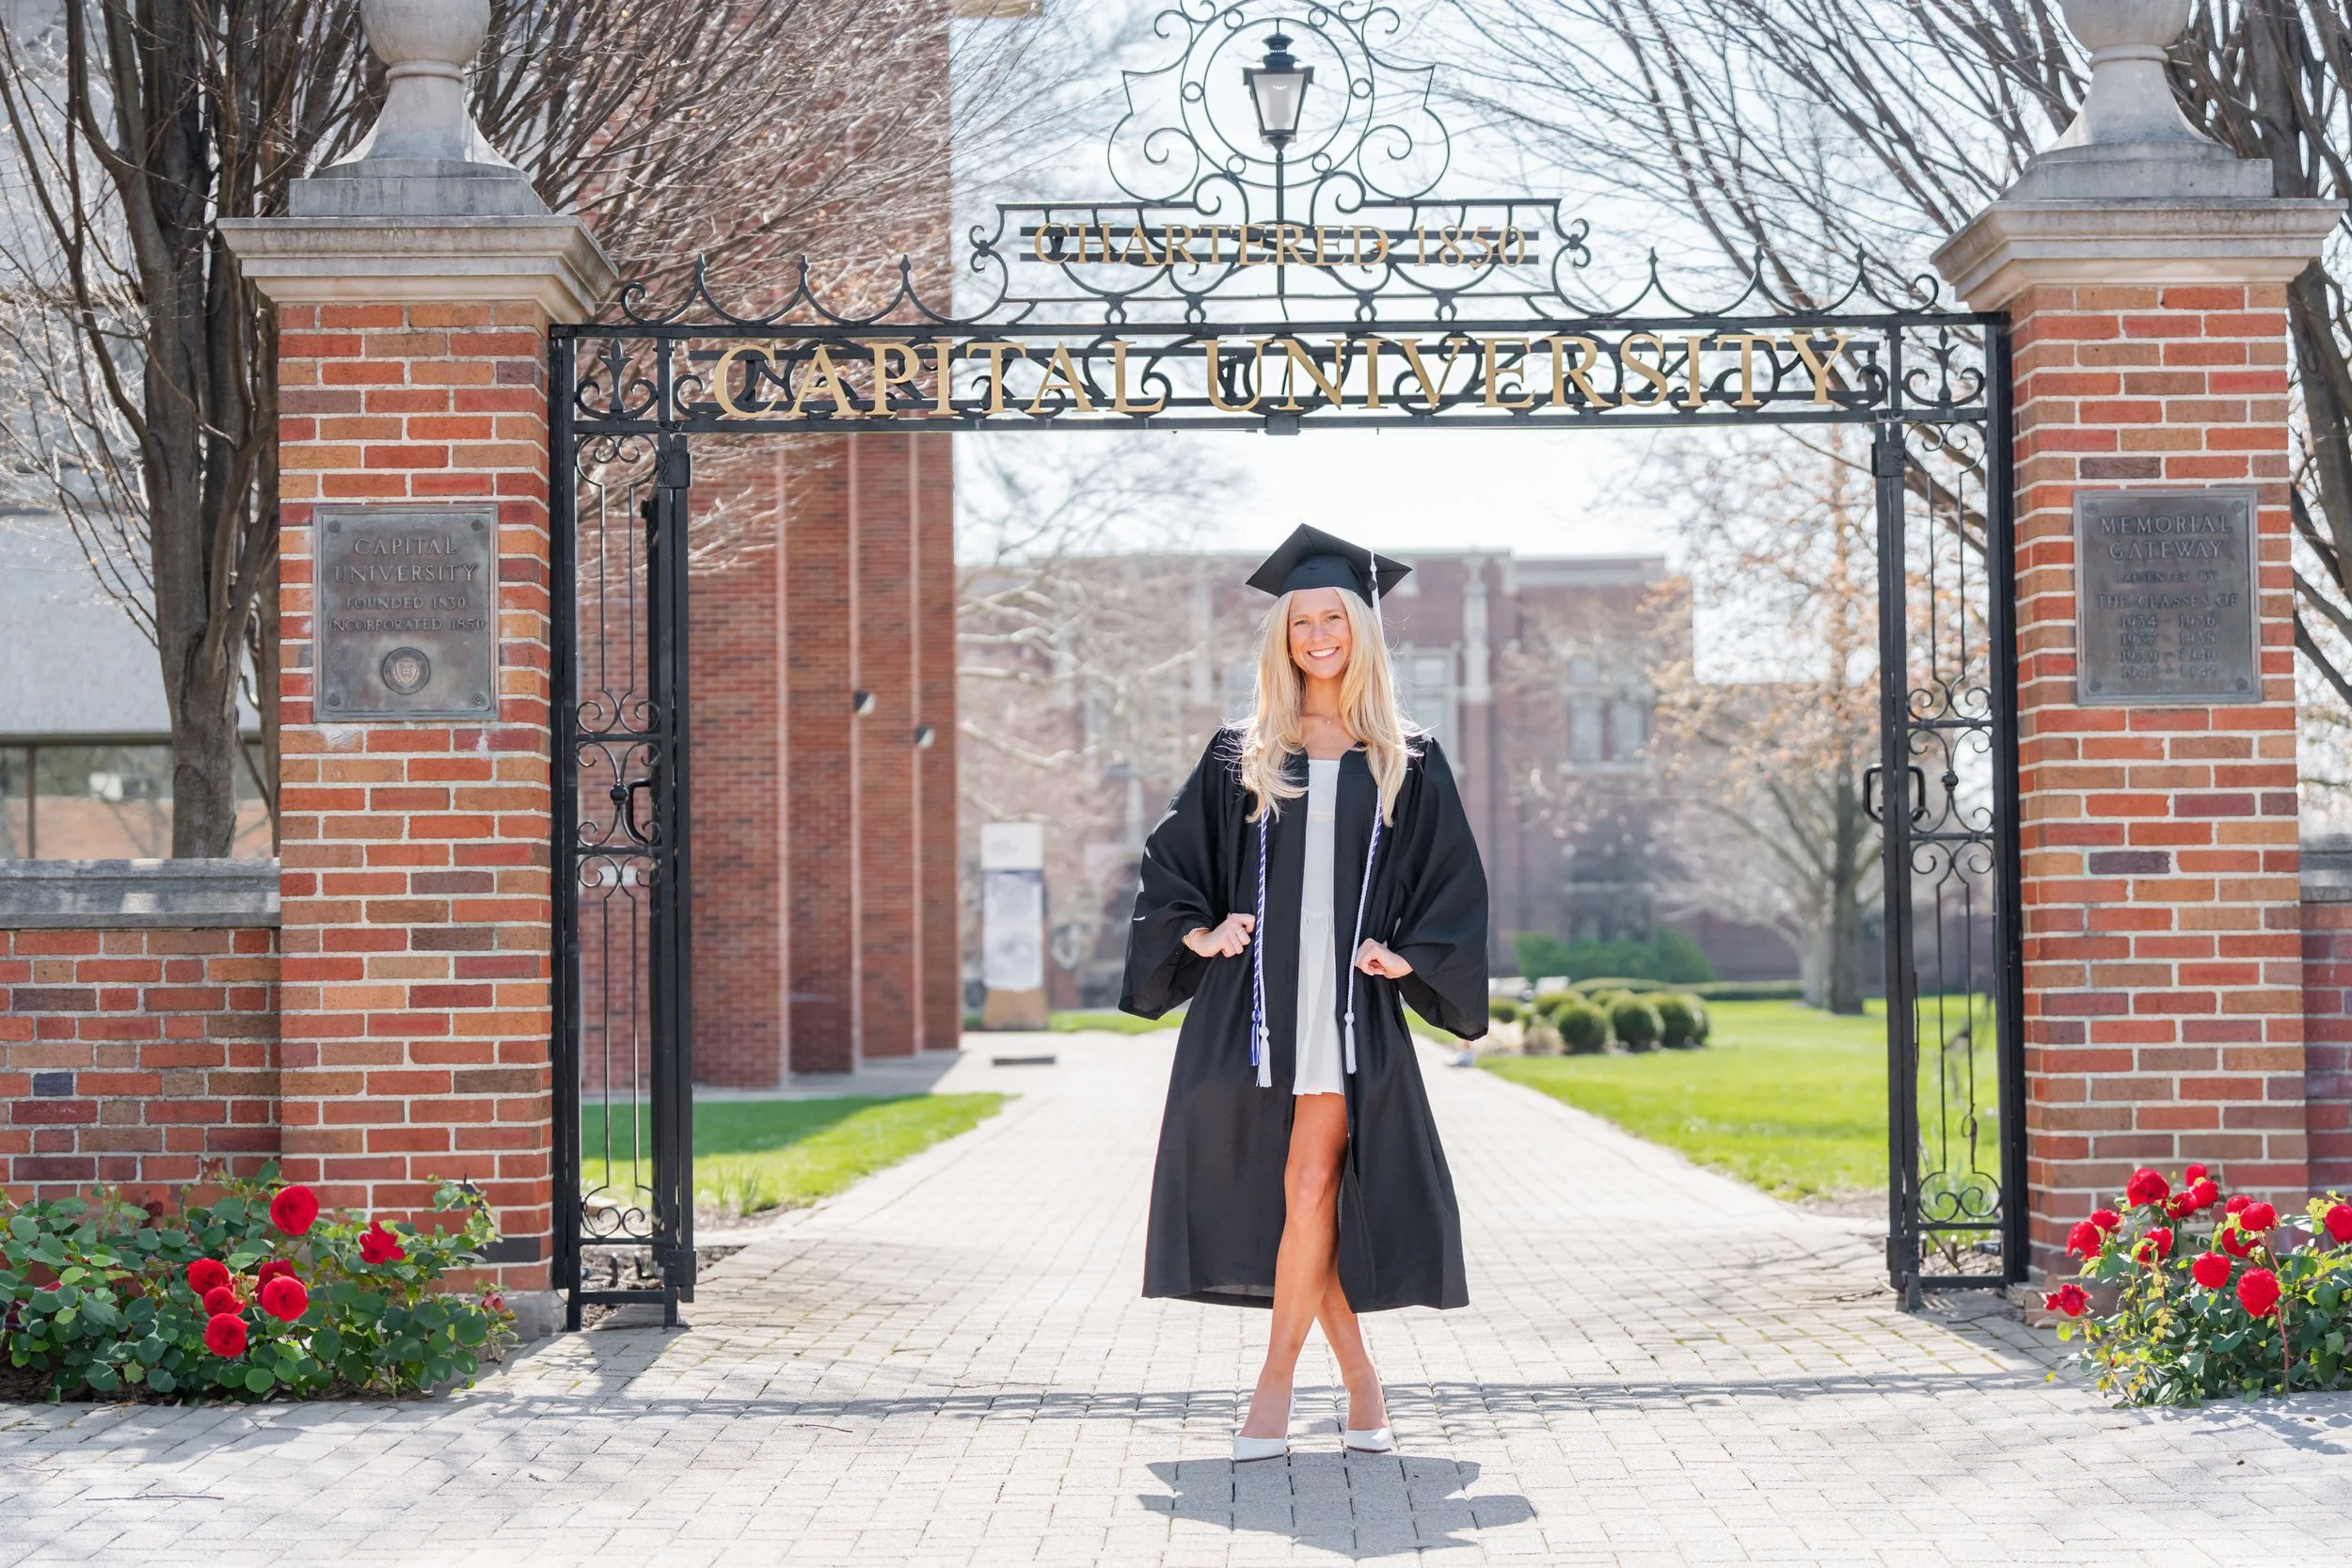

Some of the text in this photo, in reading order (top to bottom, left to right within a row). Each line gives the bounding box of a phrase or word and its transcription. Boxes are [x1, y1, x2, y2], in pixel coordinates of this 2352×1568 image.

[1034, 221, 1526, 268] CHARTERED 1850
[712, 334, 1854, 420] CAPITAL UNIVERSITY
[2099, 515, 2233, 534] MEMORIAL
[354, 537, 458, 556] CAPITAL
[2108, 541, 2223, 560] GATEWAY
[335, 564, 478, 582] UNIVERSITY
[2117, 570, 2217, 583] PRESENTED BY
[345, 596, 467, 610] FOUNDED 1830
[2097, 593, 2238, 609] THE CLASSES OF
[328, 618, 485, 632] INCORPORATED 1850
